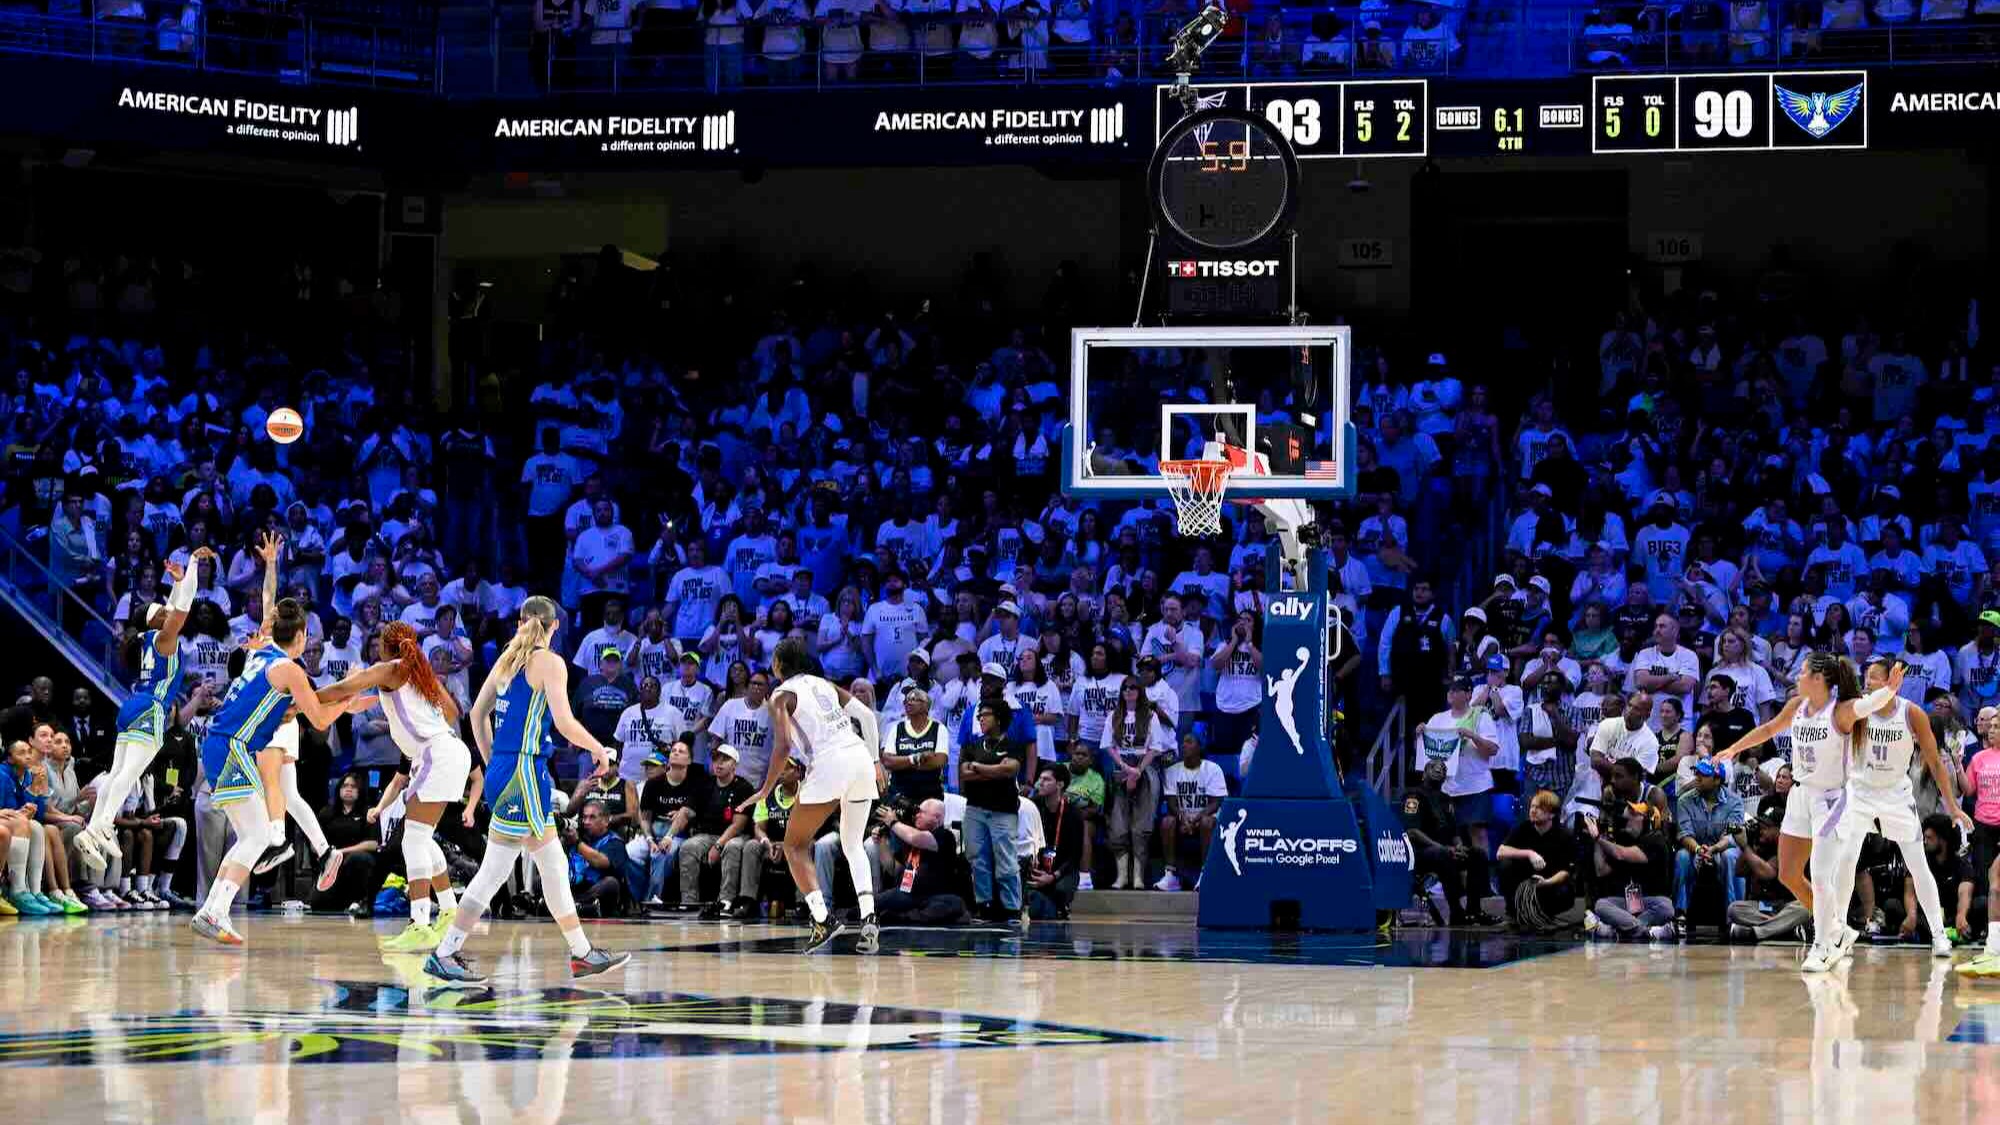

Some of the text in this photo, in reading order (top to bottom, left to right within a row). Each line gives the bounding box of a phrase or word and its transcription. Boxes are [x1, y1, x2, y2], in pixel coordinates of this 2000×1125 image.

[118, 88, 322, 126] AMERICAN FIDELITY
[1354, 100, 1416, 111] FLS TOL
[1604, 95, 1665, 106] FLS TOL
[875, 109, 1085, 131] AMERICAN FIDELITY
[1439, 109, 1477, 125] BONUS
[1494, 108, 1523, 132] 6.1
[1542, 109, 1580, 124] BONUS
[1605, 106, 1661, 137] 5 0
[1695, 90, 1753, 138] 90
[494, 116, 698, 137] AMERICAN FIDELITY
[1266, 99, 1321, 146] 93
[1357, 111, 1411, 142] 5 2
[227, 124, 320, 142] a different opinion
[985, 133, 1083, 148] a different opinion
[601, 140, 696, 152] a different opinion
[1498, 137, 1523, 150] 4TH
[1201, 141, 1247, 171] 5.9
[1351, 242, 1382, 259] 105
[1656, 239, 1690, 256] 106
[1197, 260, 1280, 278] TISSOT
[1648, 541, 1681, 556] BIG3
[1269, 597, 1314, 621] ally
[197, 642, 219, 652] NOW
[197, 652, 217, 665] IT'S
[327, 659, 349, 671] NOW
[1084, 687, 1107, 700] NOW
[669, 696, 690, 707] NOW
[734, 719, 757, 732] NOW
[734, 732, 767, 747] IT'S US
[899, 741, 934, 750] DALLAS
[1176, 781, 1198, 794] NOW
[1245, 829, 1281, 837] WNBA
[1244, 838, 1358, 853] PLAYOFFS
[1275, 853, 1315, 866] Google
[1315, 853, 1340, 865] Pixel
